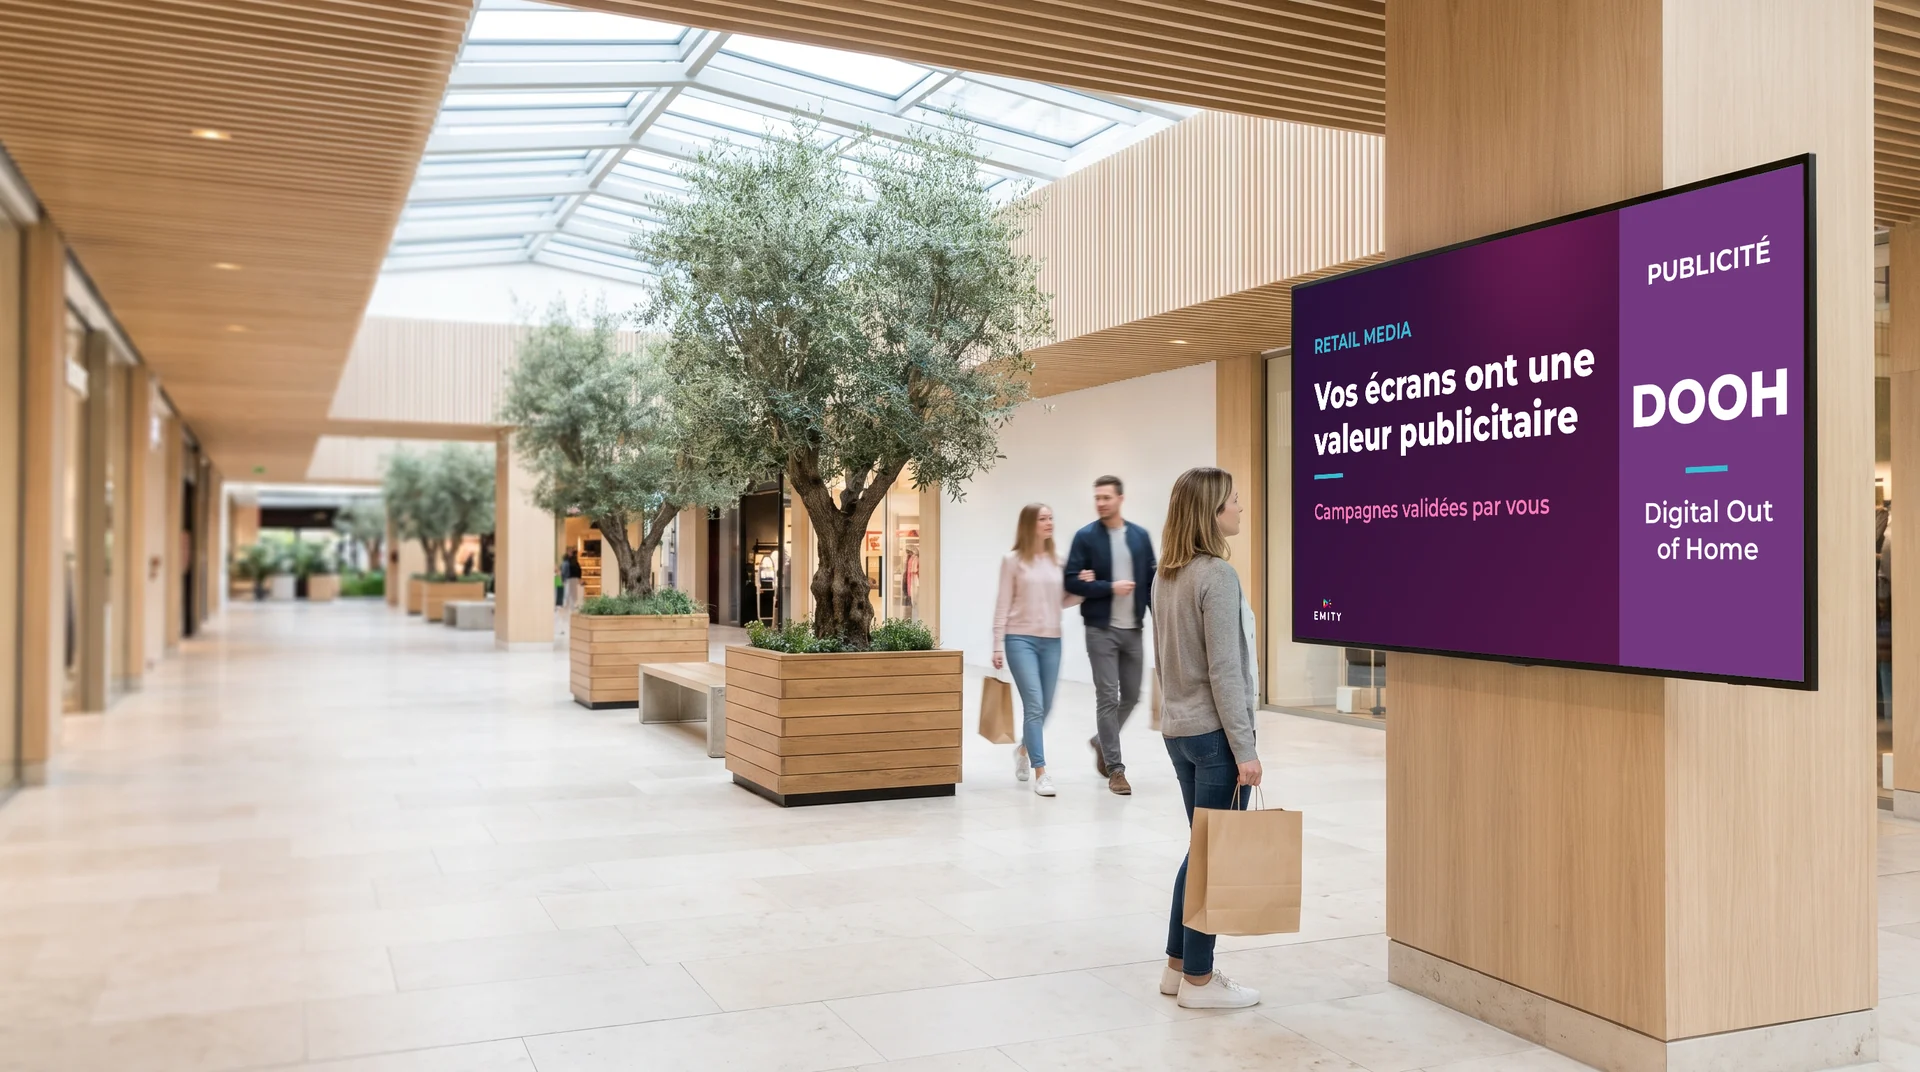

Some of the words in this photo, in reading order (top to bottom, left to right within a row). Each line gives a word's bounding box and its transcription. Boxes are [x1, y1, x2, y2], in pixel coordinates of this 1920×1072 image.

[1649, 235, 1770, 285] PUBLICITÉ
[1315, 332, 1360, 354] RETAIL
[1364, 321, 1411, 345] MEDIA
[1314, 381, 1358, 410] Vos
[1365, 369, 1456, 404] écrans
[1465, 355, 1518, 391] ont
[1529, 349, 1594, 383] une
[1633, 368, 1787, 428] DOOH
[1314, 423, 1392, 455] valeur
[1400, 397, 1579, 456] publicitaire
[1315, 504, 1398, 524] Campagnes
[1402, 497, 1467, 517] validées
[1473, 501, 1501, 521] par
[1506, 499, 1549, 515] vous
[1646, 500, 1718, 529] Digital
[1727, 500, 1773, 522] Out
[1658, 537, 1680, 559] of
[1687, 538, 1758, 560] Home
[1313, 610, 1342, 622] EMITY
